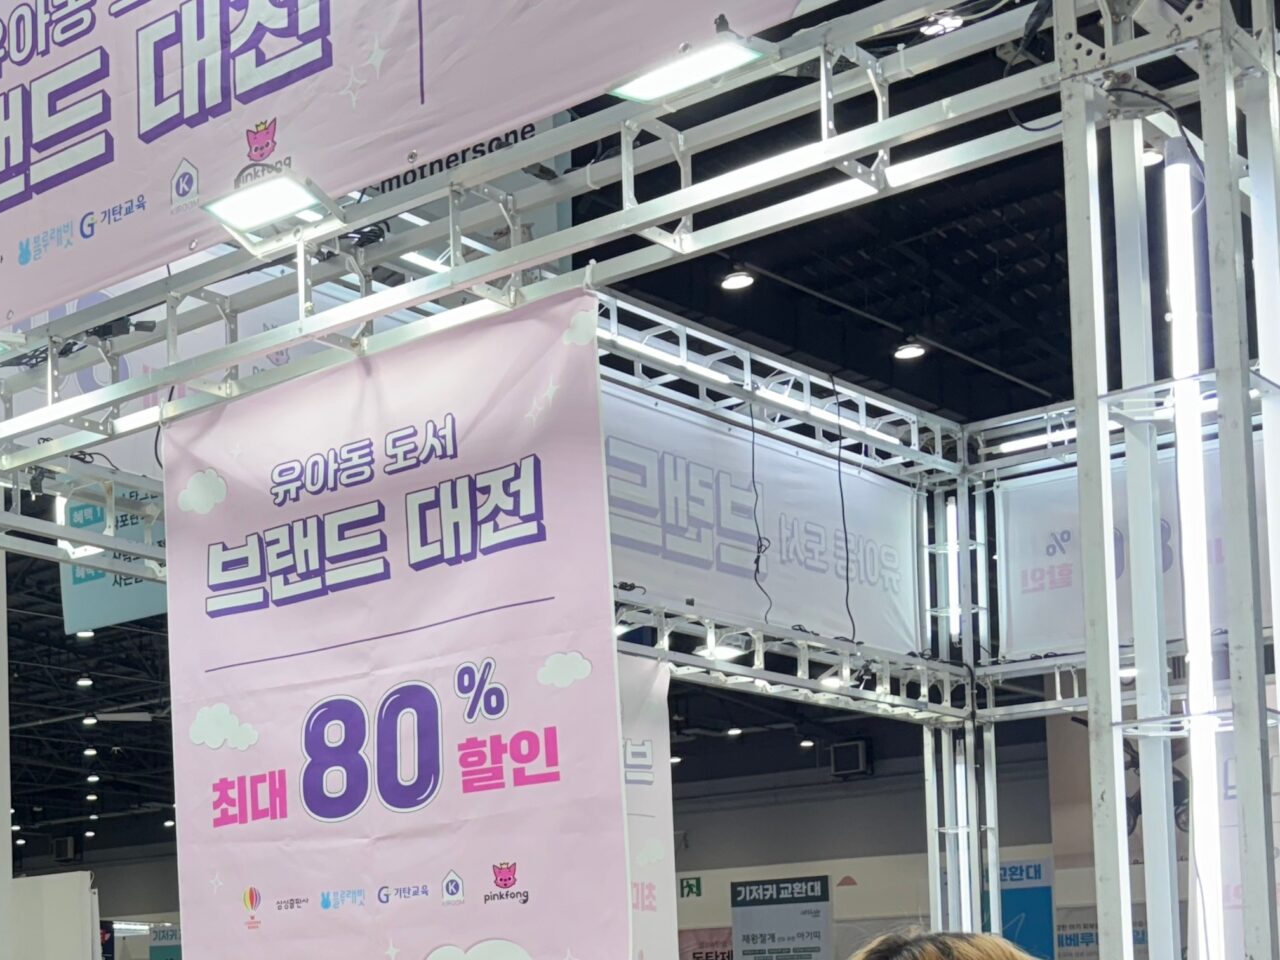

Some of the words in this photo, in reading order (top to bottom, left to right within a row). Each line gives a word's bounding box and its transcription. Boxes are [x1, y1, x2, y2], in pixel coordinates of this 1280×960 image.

[136, 0, 333, 144] 대전
[100, 194, 148, 226] 기탄교육
[32, 219, 75, 263] 블루래빗
[270, 439, 374, 506] 유아동
[383, 413, 458, 475] 도서
[205, 500, 391, 618] 브랜드
[404, 453, 547, 572] 대전
[212, 769, 288, 828] 최대
[457, 726, 561, 794] 할인
[393, 884, 430, 900] 기탄교육
[483, 888, 530, 905] pinkfong
[736, 884, 777, 901] 기저귀
[779, 880, 822, 899] 교환대
